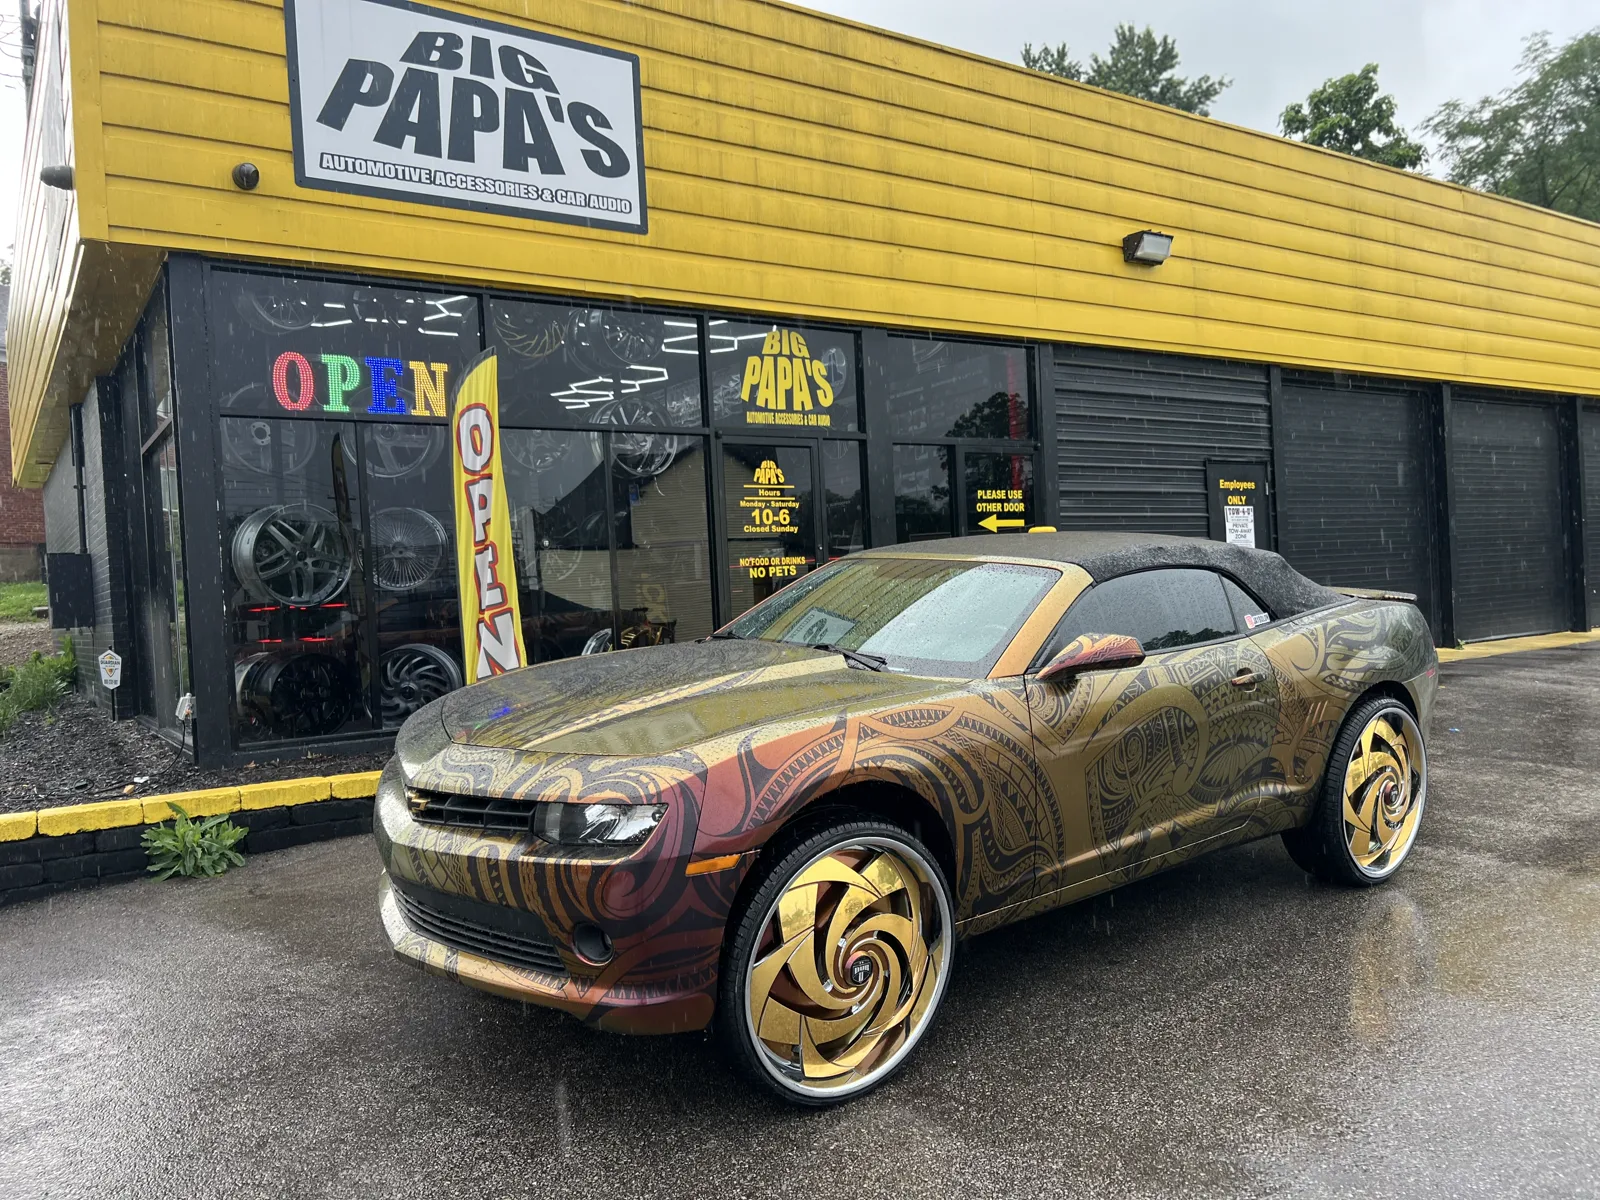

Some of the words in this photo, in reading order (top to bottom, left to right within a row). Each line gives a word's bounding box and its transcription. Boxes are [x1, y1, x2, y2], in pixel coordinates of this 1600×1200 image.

[399, 31, 561, 95] BIG
[316, 58, 631, 178] PAPA'S
[319, 152, 433, 185] AUTOMOTIVE
[434, 171, 539, 202] ACCESSORIES
[541, 187, 555, 202] &
[555, 190, 588, 208] CAR
[588, 193, 632, 215] AUDIO
[762, 329, 810, 358] BIG
[272, 351, 448, 417] OPEN
[741, 355, 834, 411] PAPA'S
[746, 411, 774, 424] AUTOMOTIVE
[775, 412, 804, 425] ACCESSORIES
[808, 414, 817, 426] CAR
[818, 414, 831, 426] AUDIO
[760, 460, 777, 468] BIG
[754, 468, 785, 484] PAPA'S
[1219, 479, 1256, 491] Employees
[978, 490, 1006, 499] PLEASE
[1008, 490, 1023, 499] USE
[1227, 495, 1247, 505] ONLY
[976, 503, 1003, 512] OTHER
[1003, 503, 1025, 512] DOOR
[751, 509, 790, 525] 10-6
[772, 525, 798, 533] Sunday
[456, 402, 522, 679] OPEN
[740, 558, 750, 566] NO
[751, 558, 769, 566] FOOD
[771, 557, 780, 565] OR
[781, 556, 806, 565] DRINKS
[750, 568, 766, 578] NO
[769, 565, 797, 577] PETS
